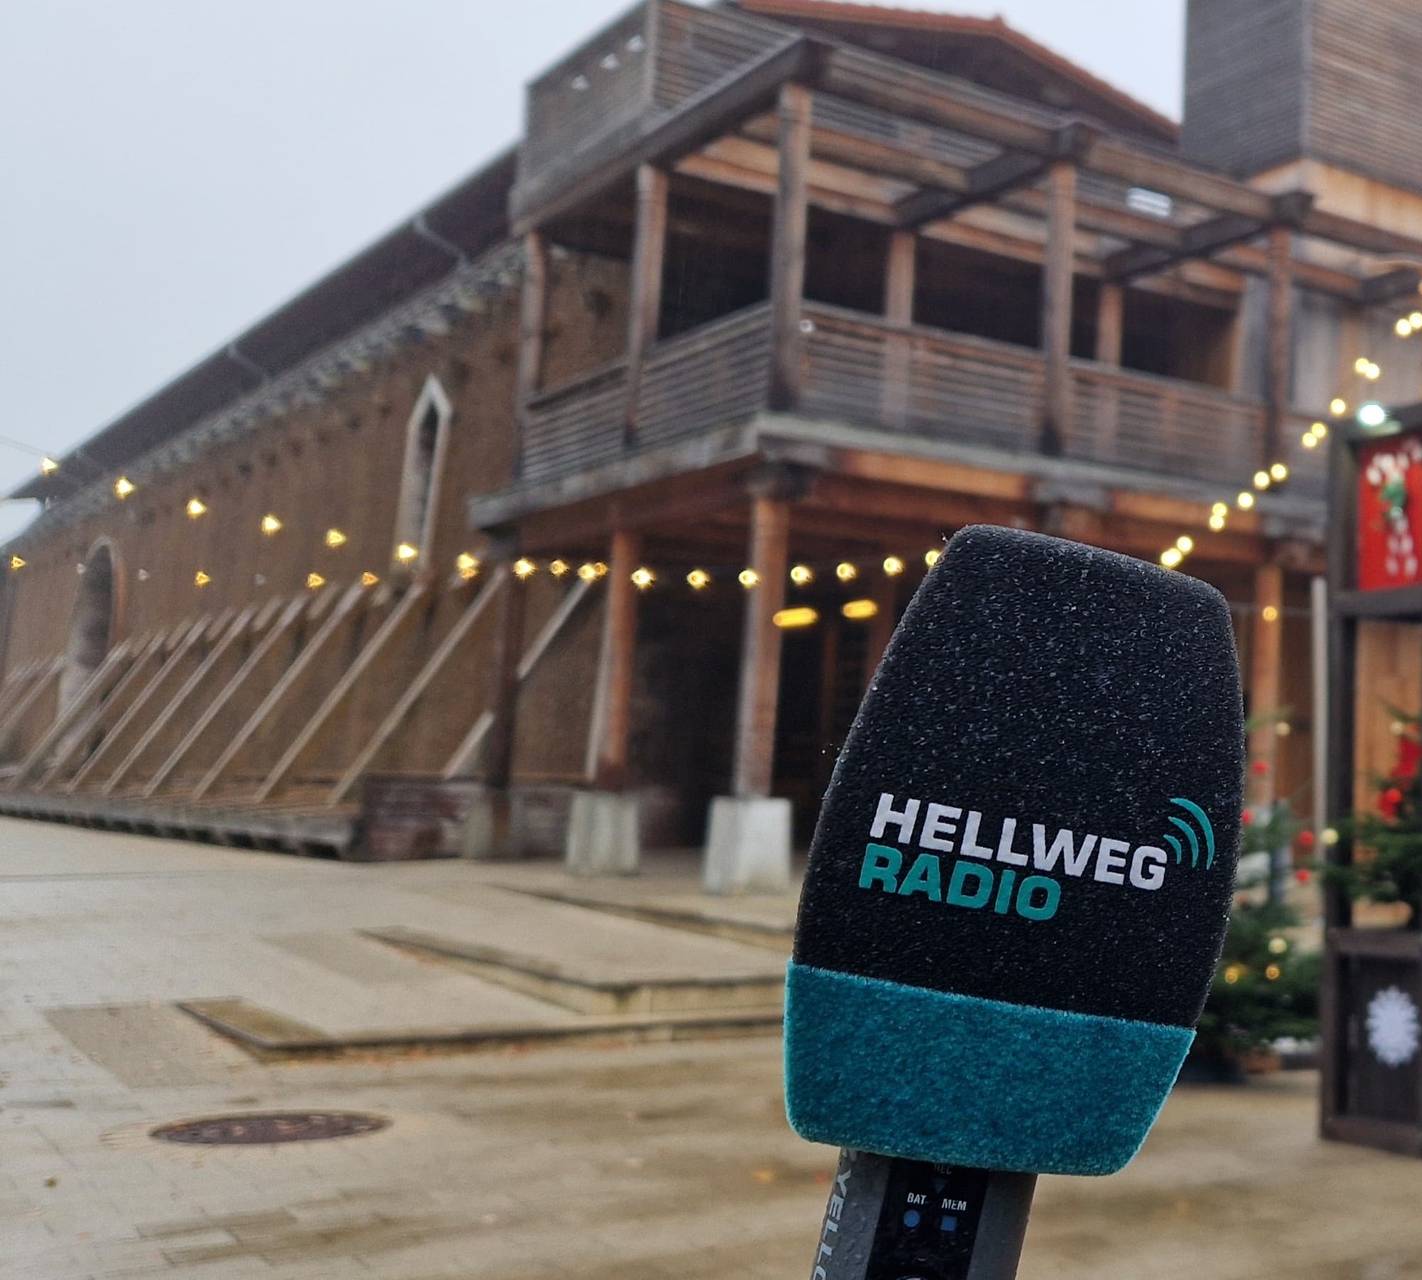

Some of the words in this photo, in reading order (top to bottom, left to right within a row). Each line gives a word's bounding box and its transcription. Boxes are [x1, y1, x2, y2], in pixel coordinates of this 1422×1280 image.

[869, 793, 1167, 890] HELLWEG
[858, 843, 1061, 921] RADIO
[907, 1193, 927, 1205] BAT
[941, 1198, 967, 1211] MEM
